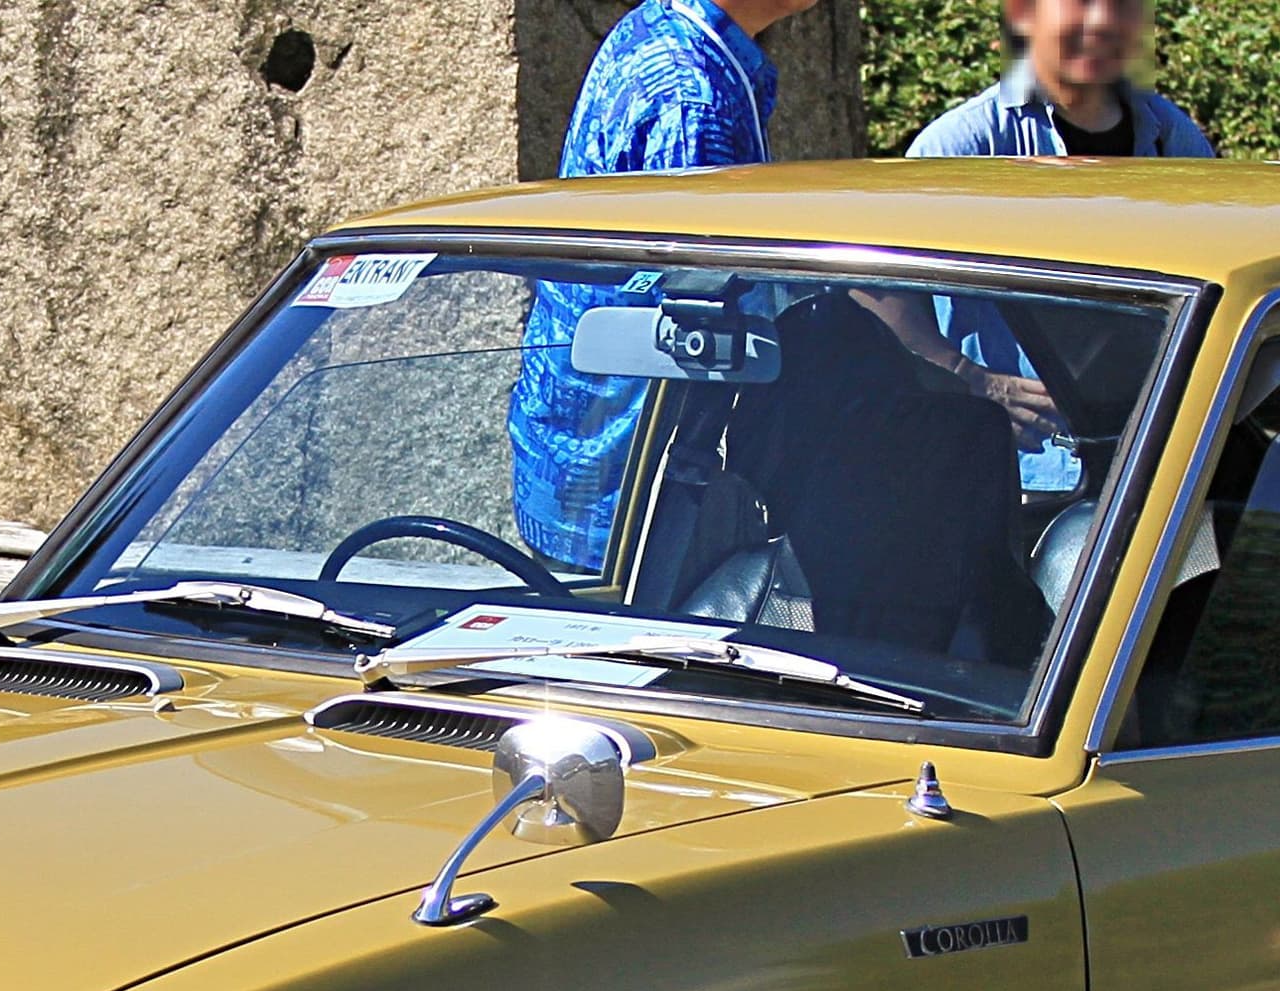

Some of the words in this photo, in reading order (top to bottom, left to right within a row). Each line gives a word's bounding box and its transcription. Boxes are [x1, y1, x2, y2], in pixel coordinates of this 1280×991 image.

[339, 259, 425, 285] ENTRANT
[628, 280, 651, 291] 12
[919, 919, 1018, 955] COROLLA
